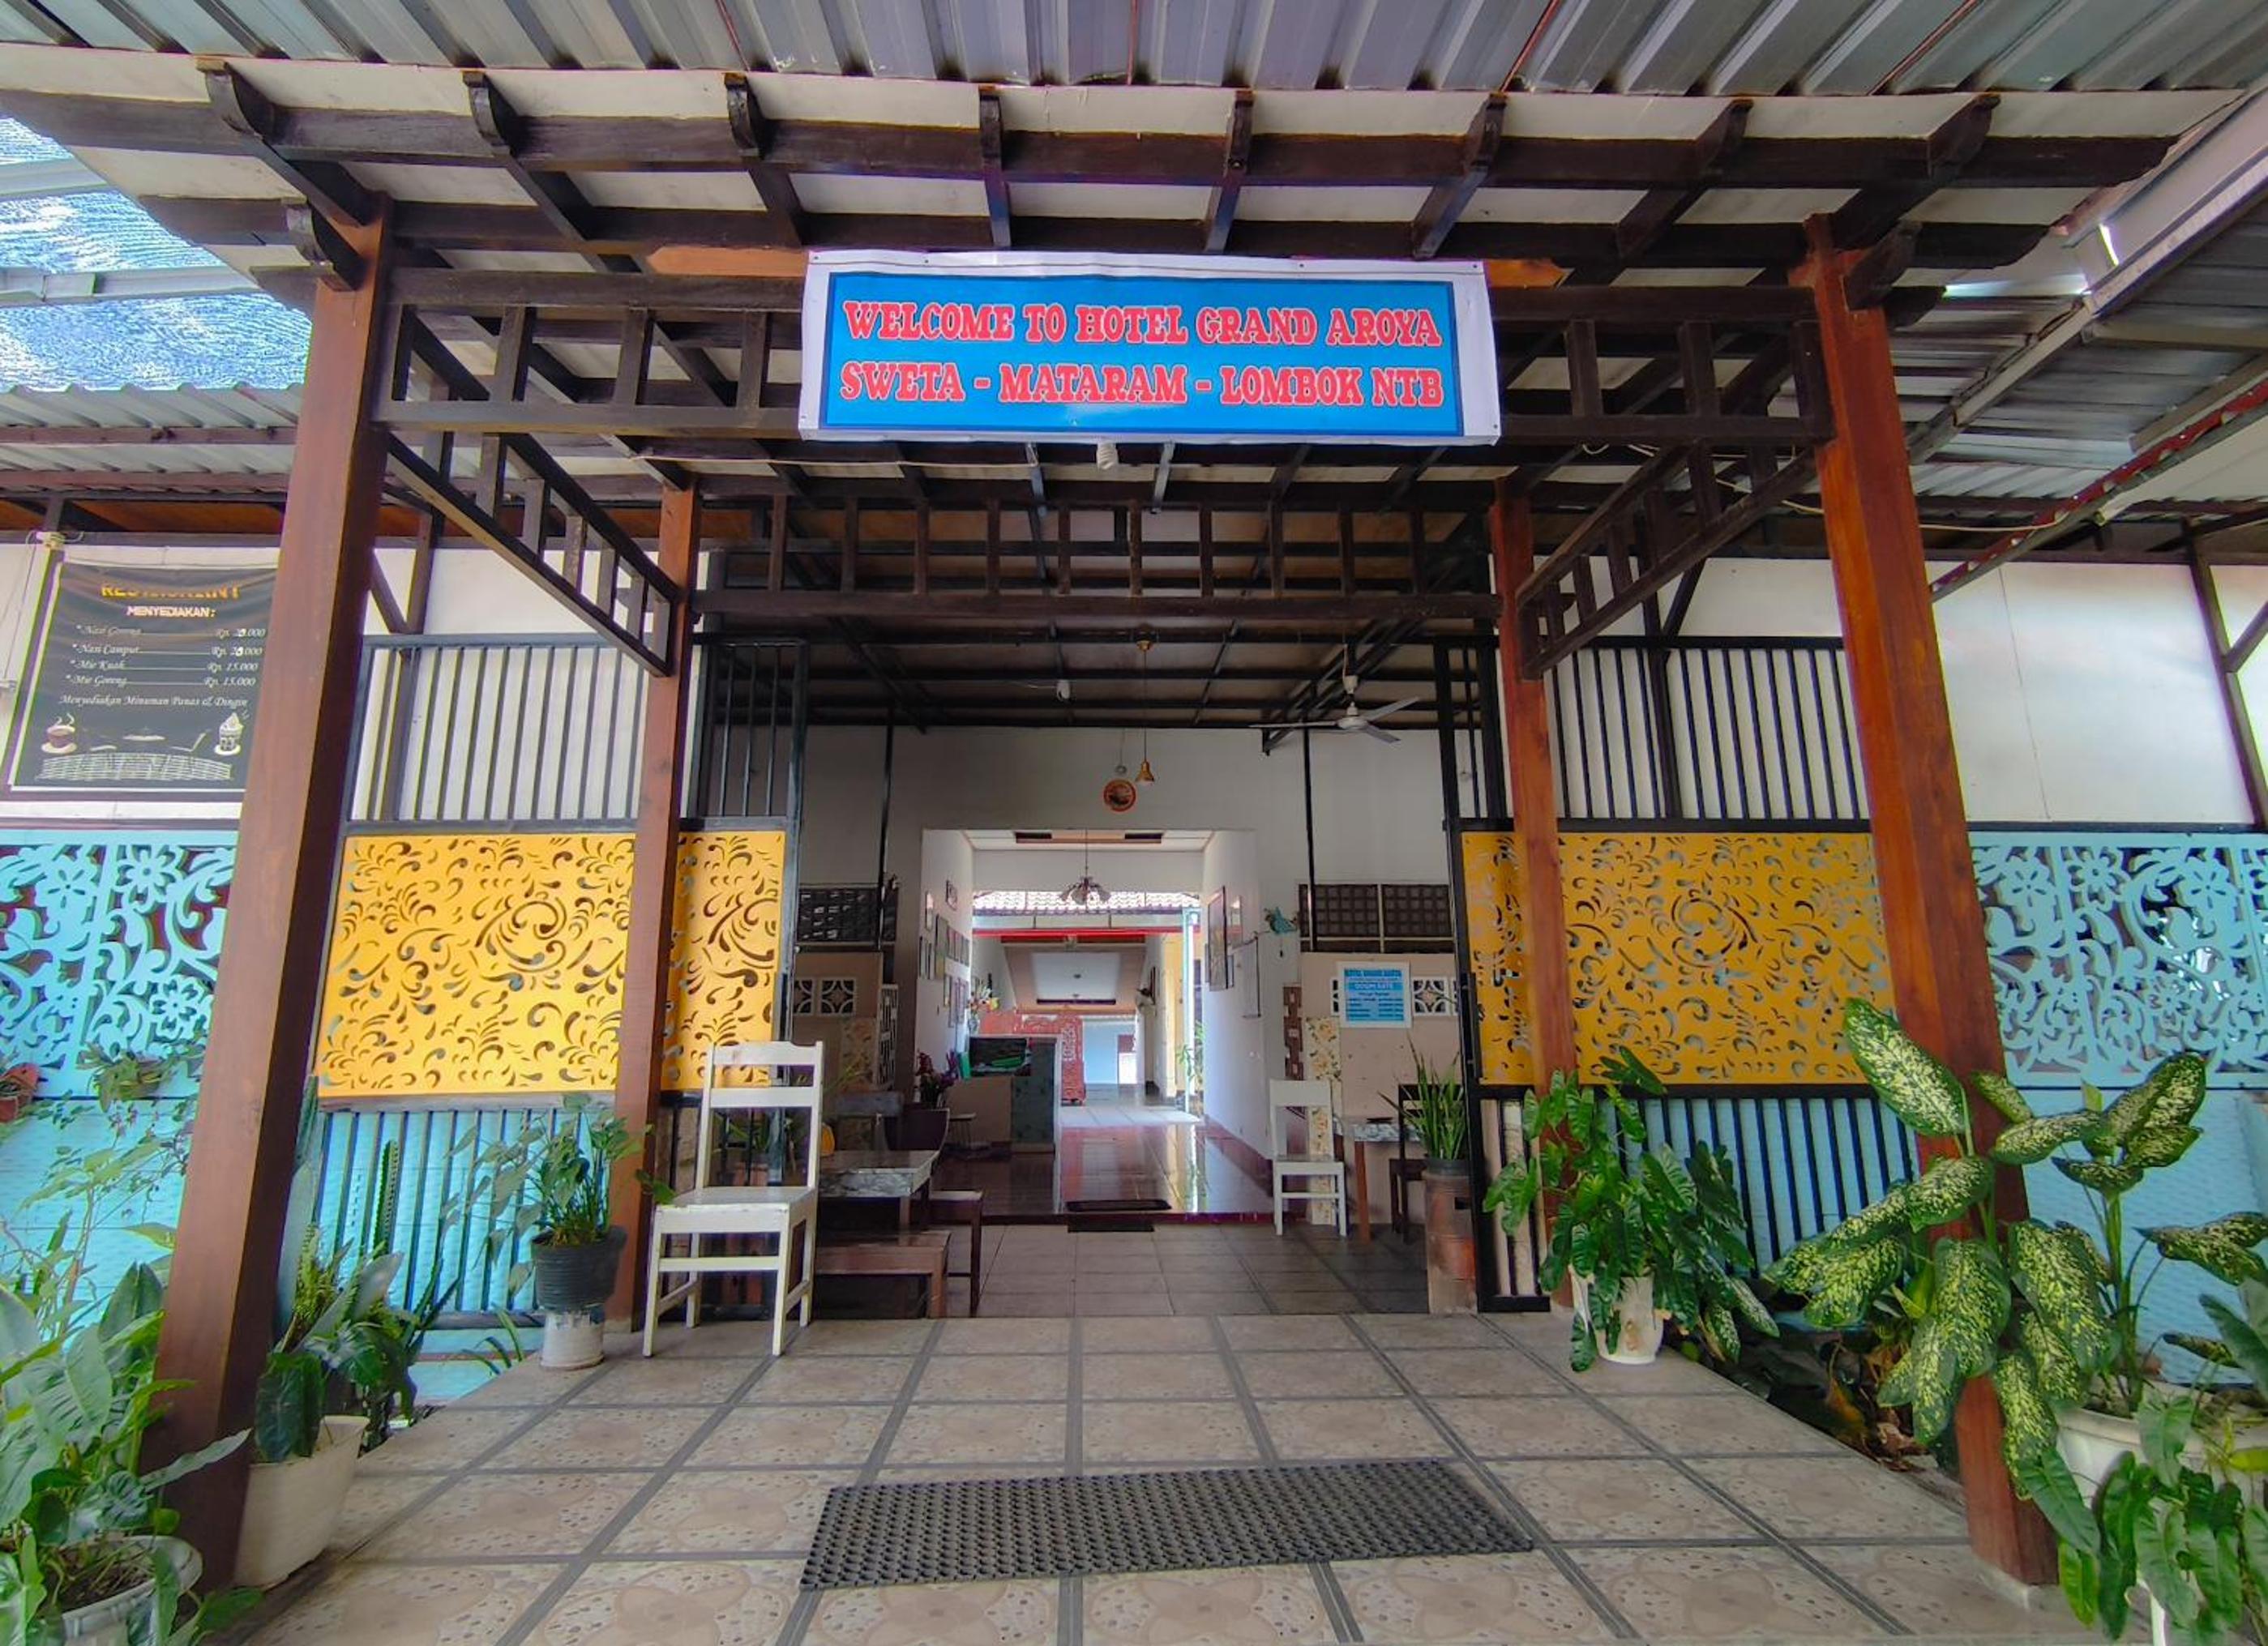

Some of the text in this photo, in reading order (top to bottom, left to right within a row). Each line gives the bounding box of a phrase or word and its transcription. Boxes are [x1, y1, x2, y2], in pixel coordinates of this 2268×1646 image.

[843, 301, 1442, 347] WELCOME TO HOTEL GRAND AROYA
[840, 361, 965, 402] SWETA
[999, 363, 1187, 404] MATARAM
[1219, 366, 1363, 406] LOMBOK
[1371, 367, 1444, 407] NTB
